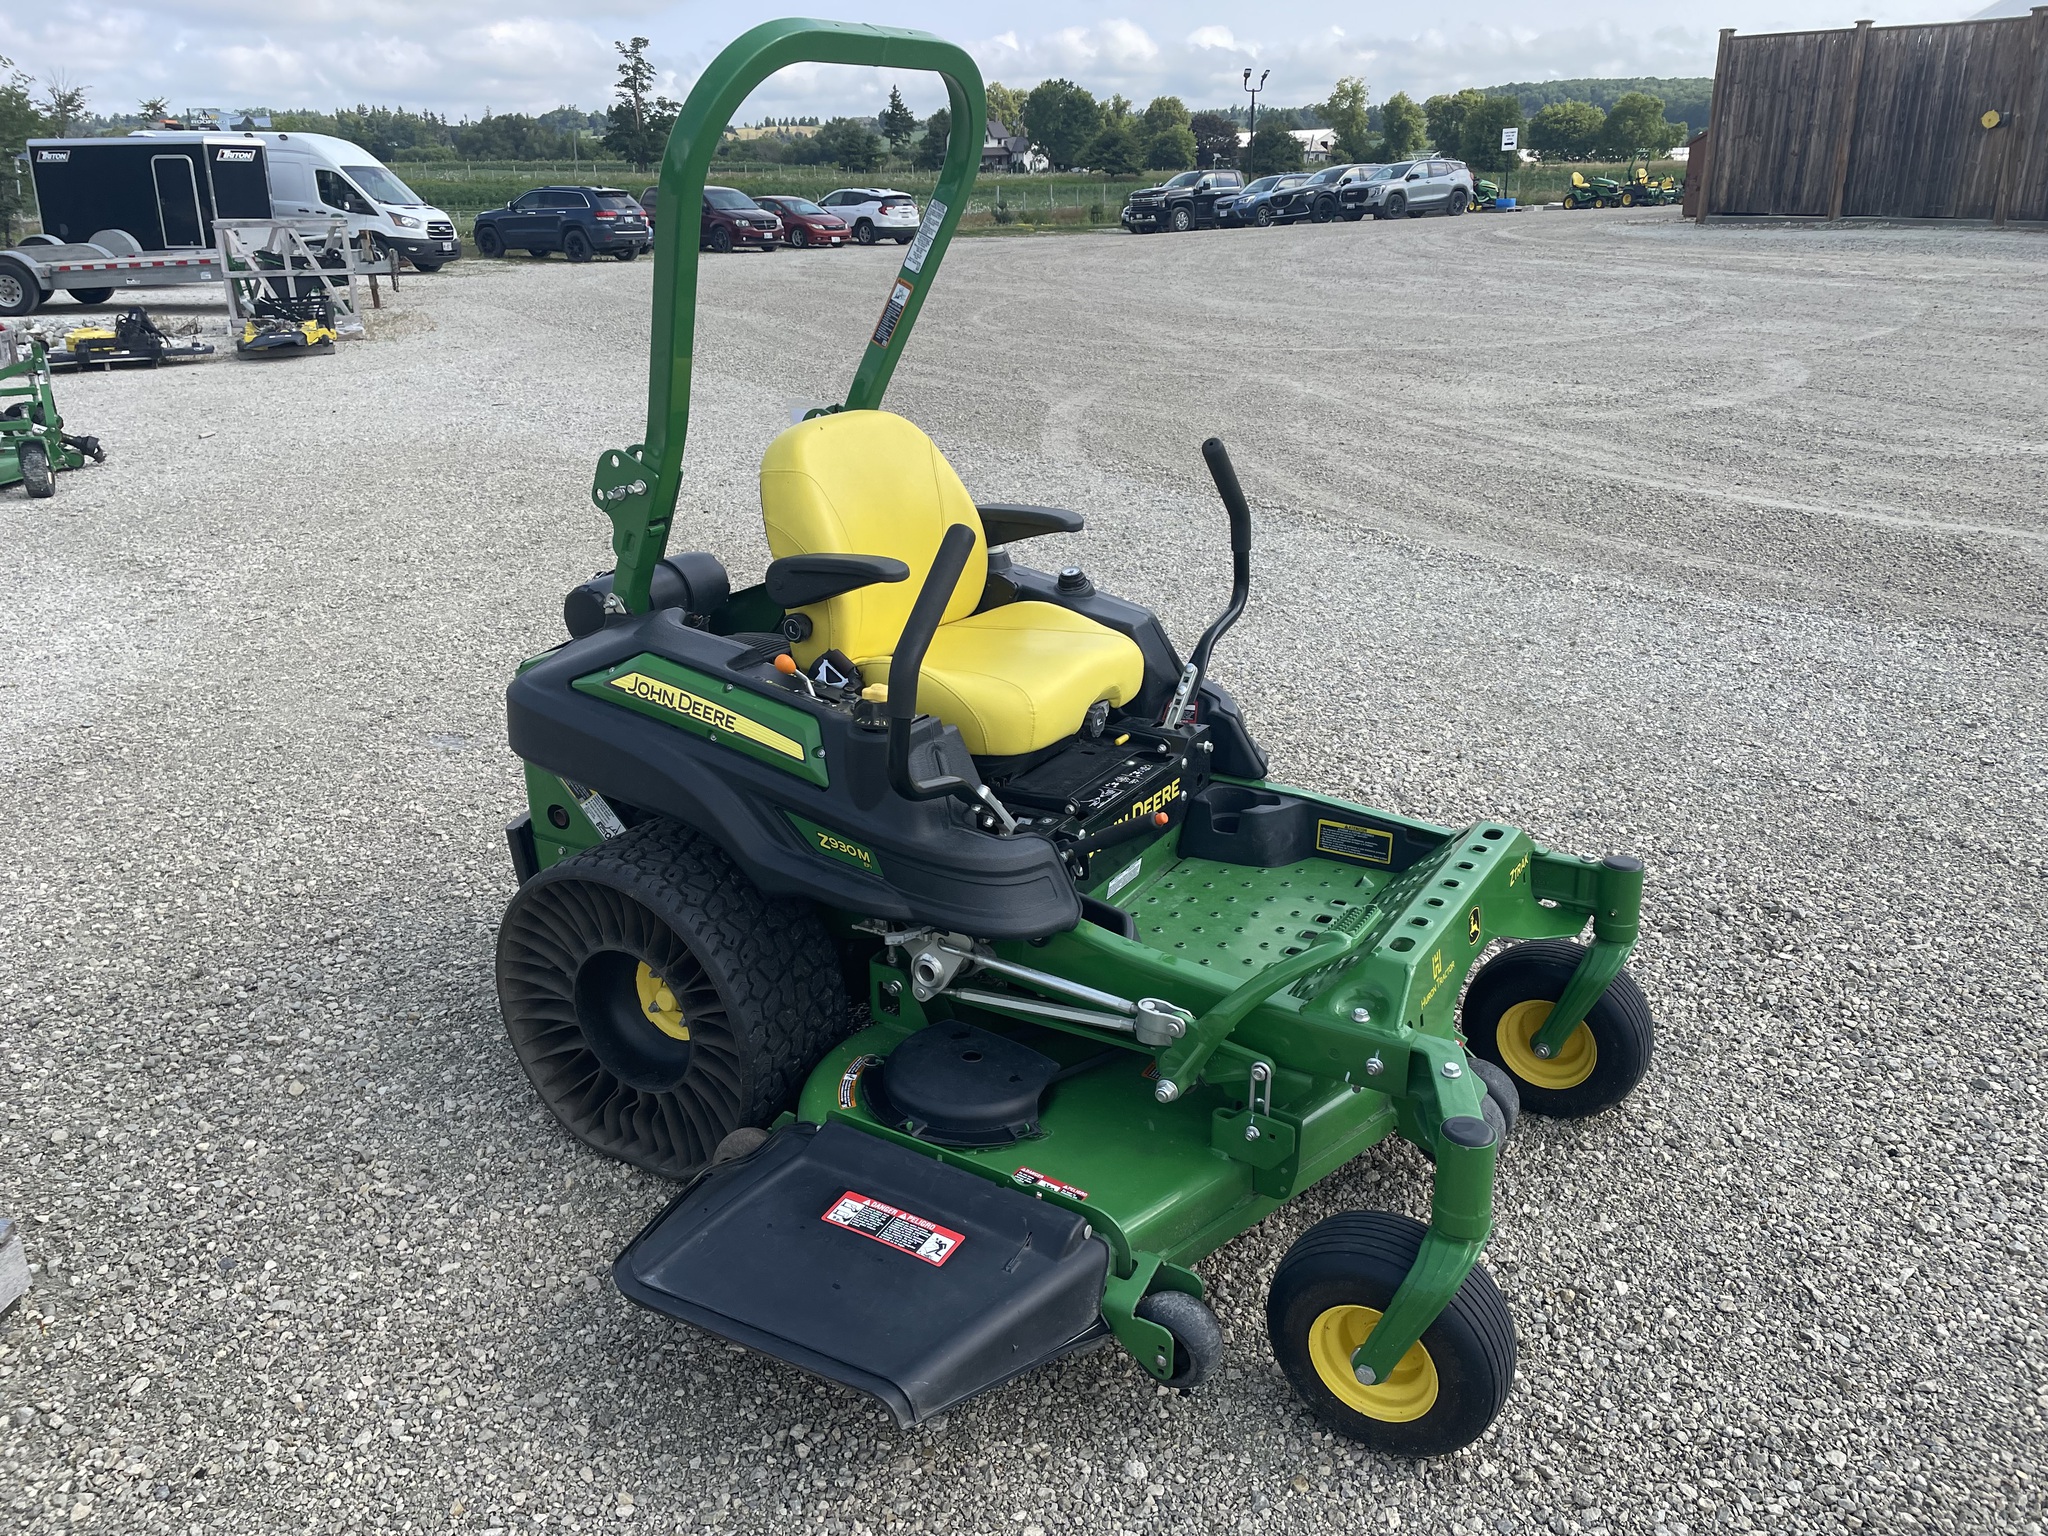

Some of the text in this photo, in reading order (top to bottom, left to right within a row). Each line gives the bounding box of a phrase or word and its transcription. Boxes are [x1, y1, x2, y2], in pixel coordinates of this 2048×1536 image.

[41, 151, 67, 160] TRITON
[222, 150, 252, 160] TRITON
[627, 676, 737, 730] JOHN DEERE
[1132, 777, 1181, 818] DEERE
[817, 832, 871, 863] Z930M
[1509, 852, 1529, 887] ZTRAK
[1420, 960, 1455, 1010] HURON TRACTOR
[870, 1201, 899, 1216] DANGER
[906, 1215, 937, 1231] PELIGRO
